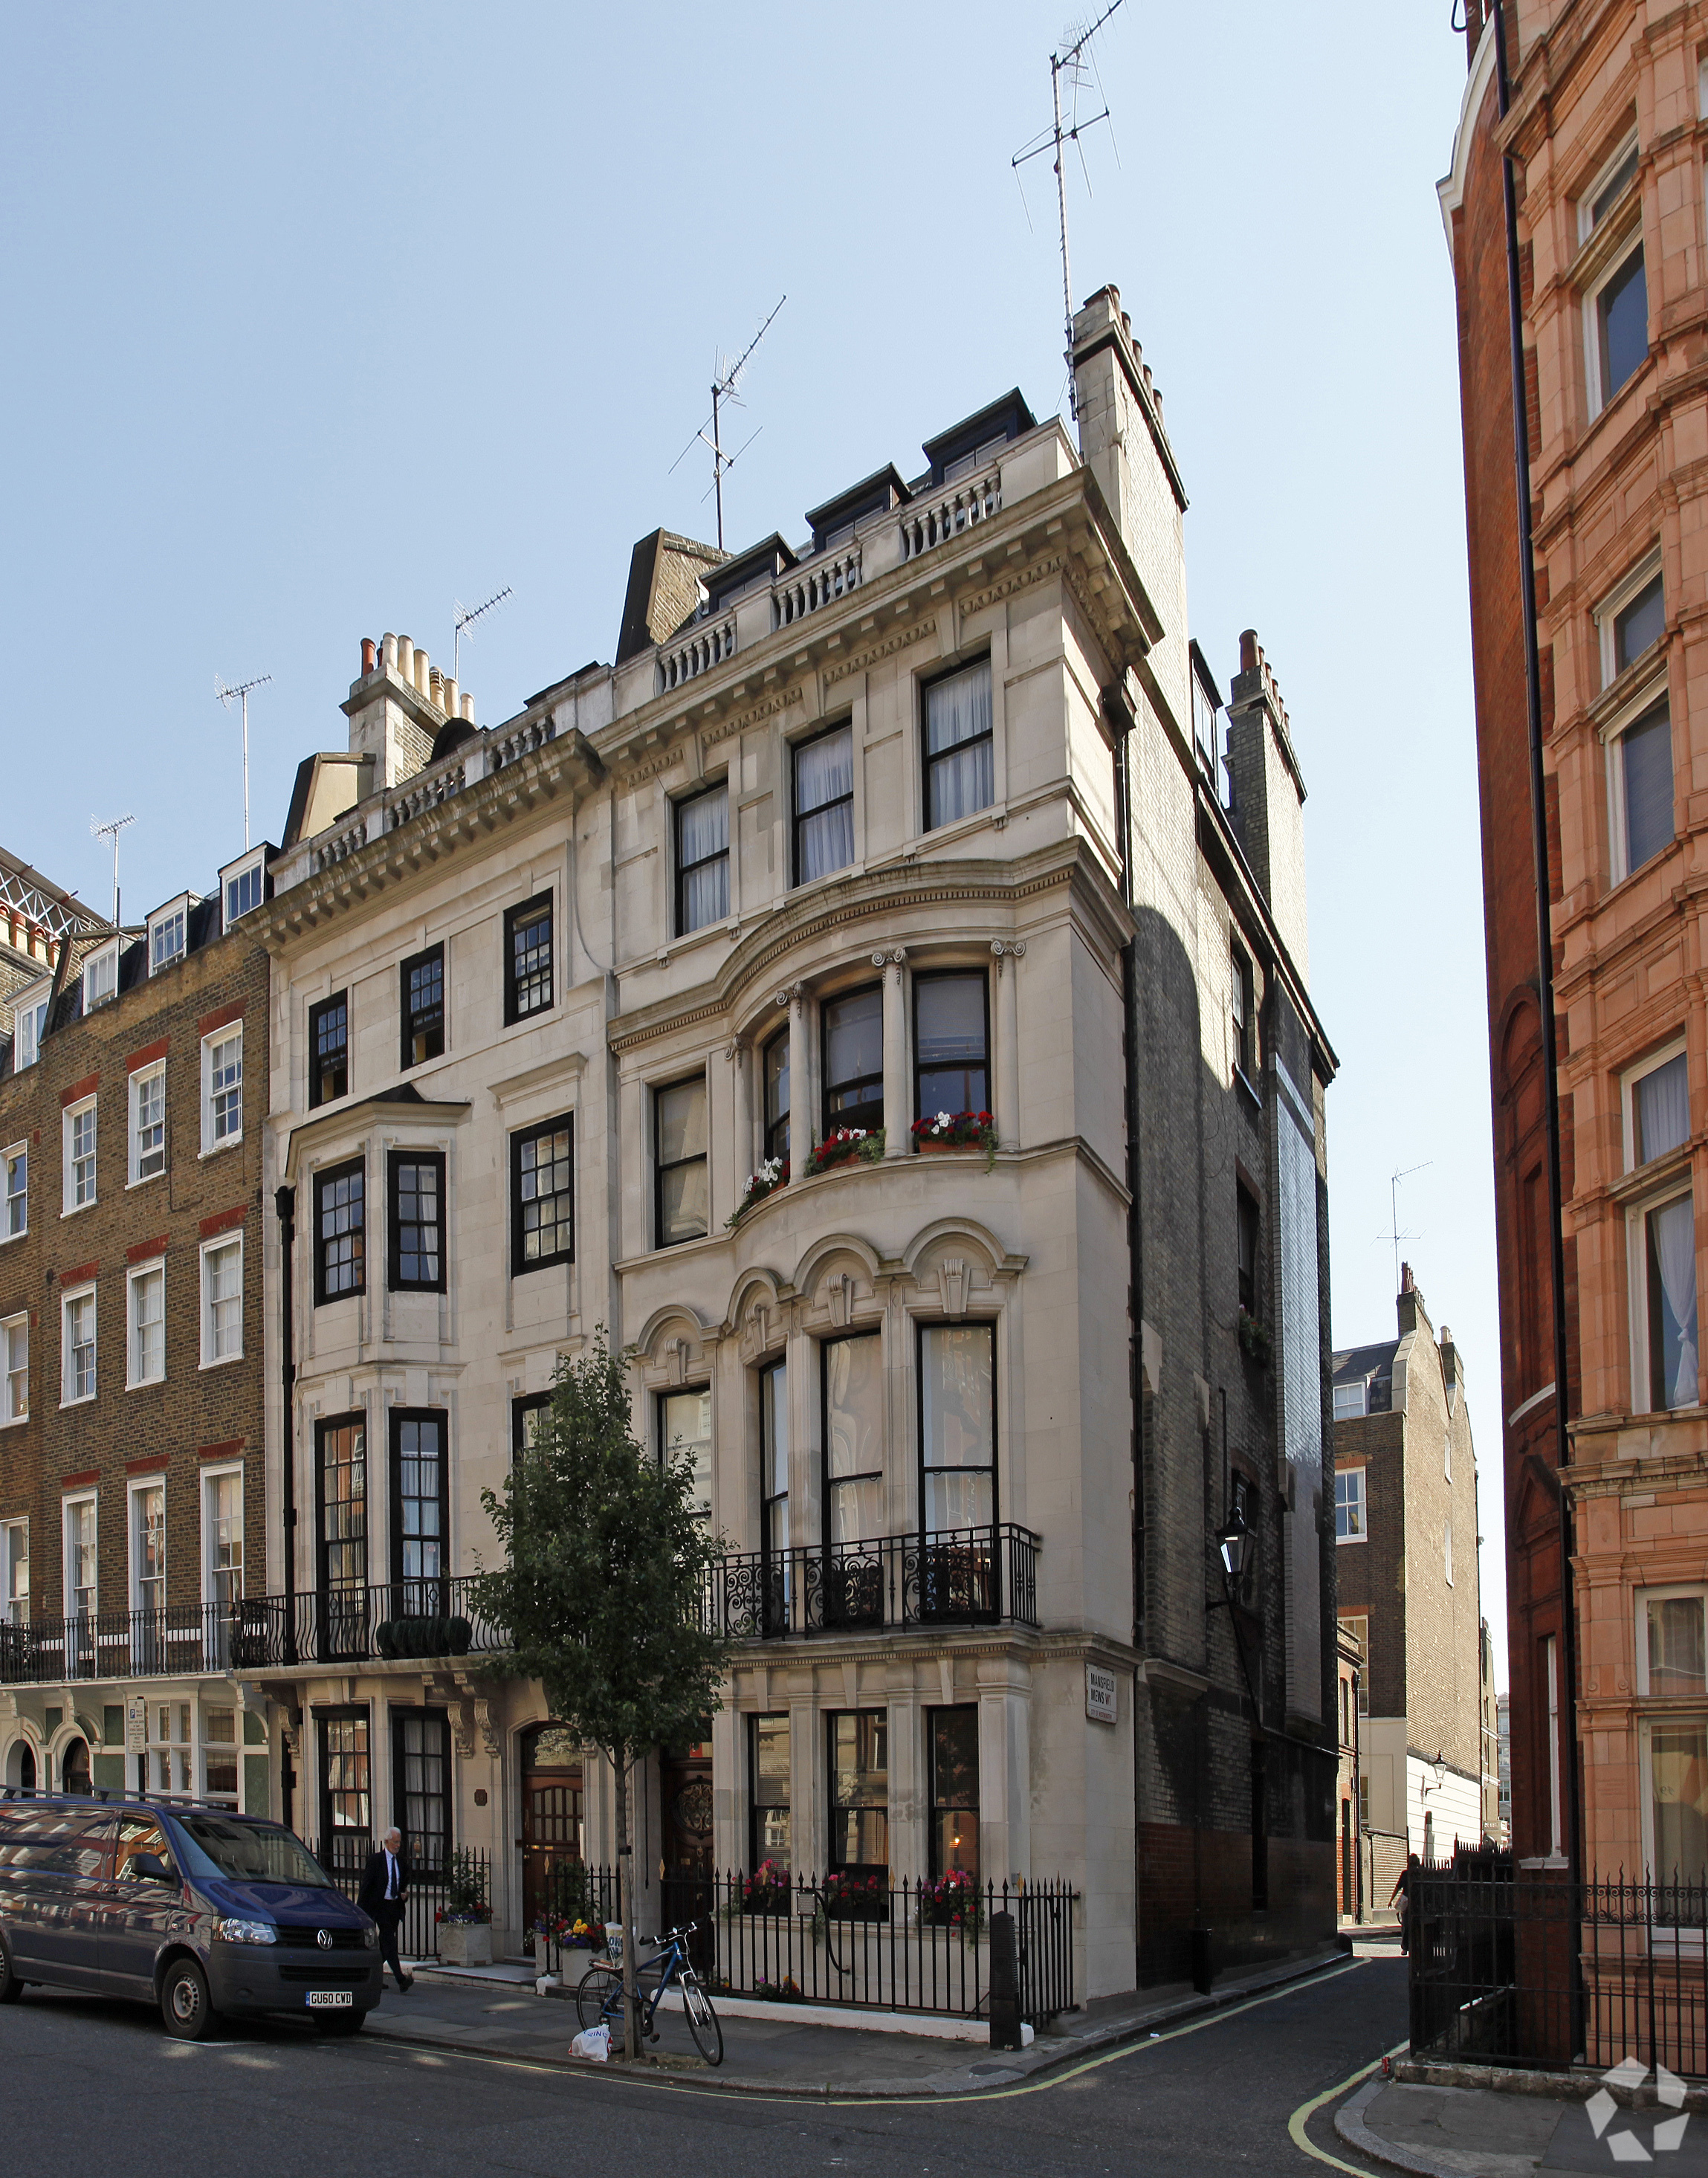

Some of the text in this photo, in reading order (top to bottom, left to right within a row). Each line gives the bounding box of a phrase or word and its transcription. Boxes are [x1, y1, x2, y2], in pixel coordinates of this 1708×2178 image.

[1090, 1673, 1114, 1693] MANSFIELD
[1090, 1688, 1111, 1706] MEWS W1
[311, 1993, 351, 2004] GU60 CWD
